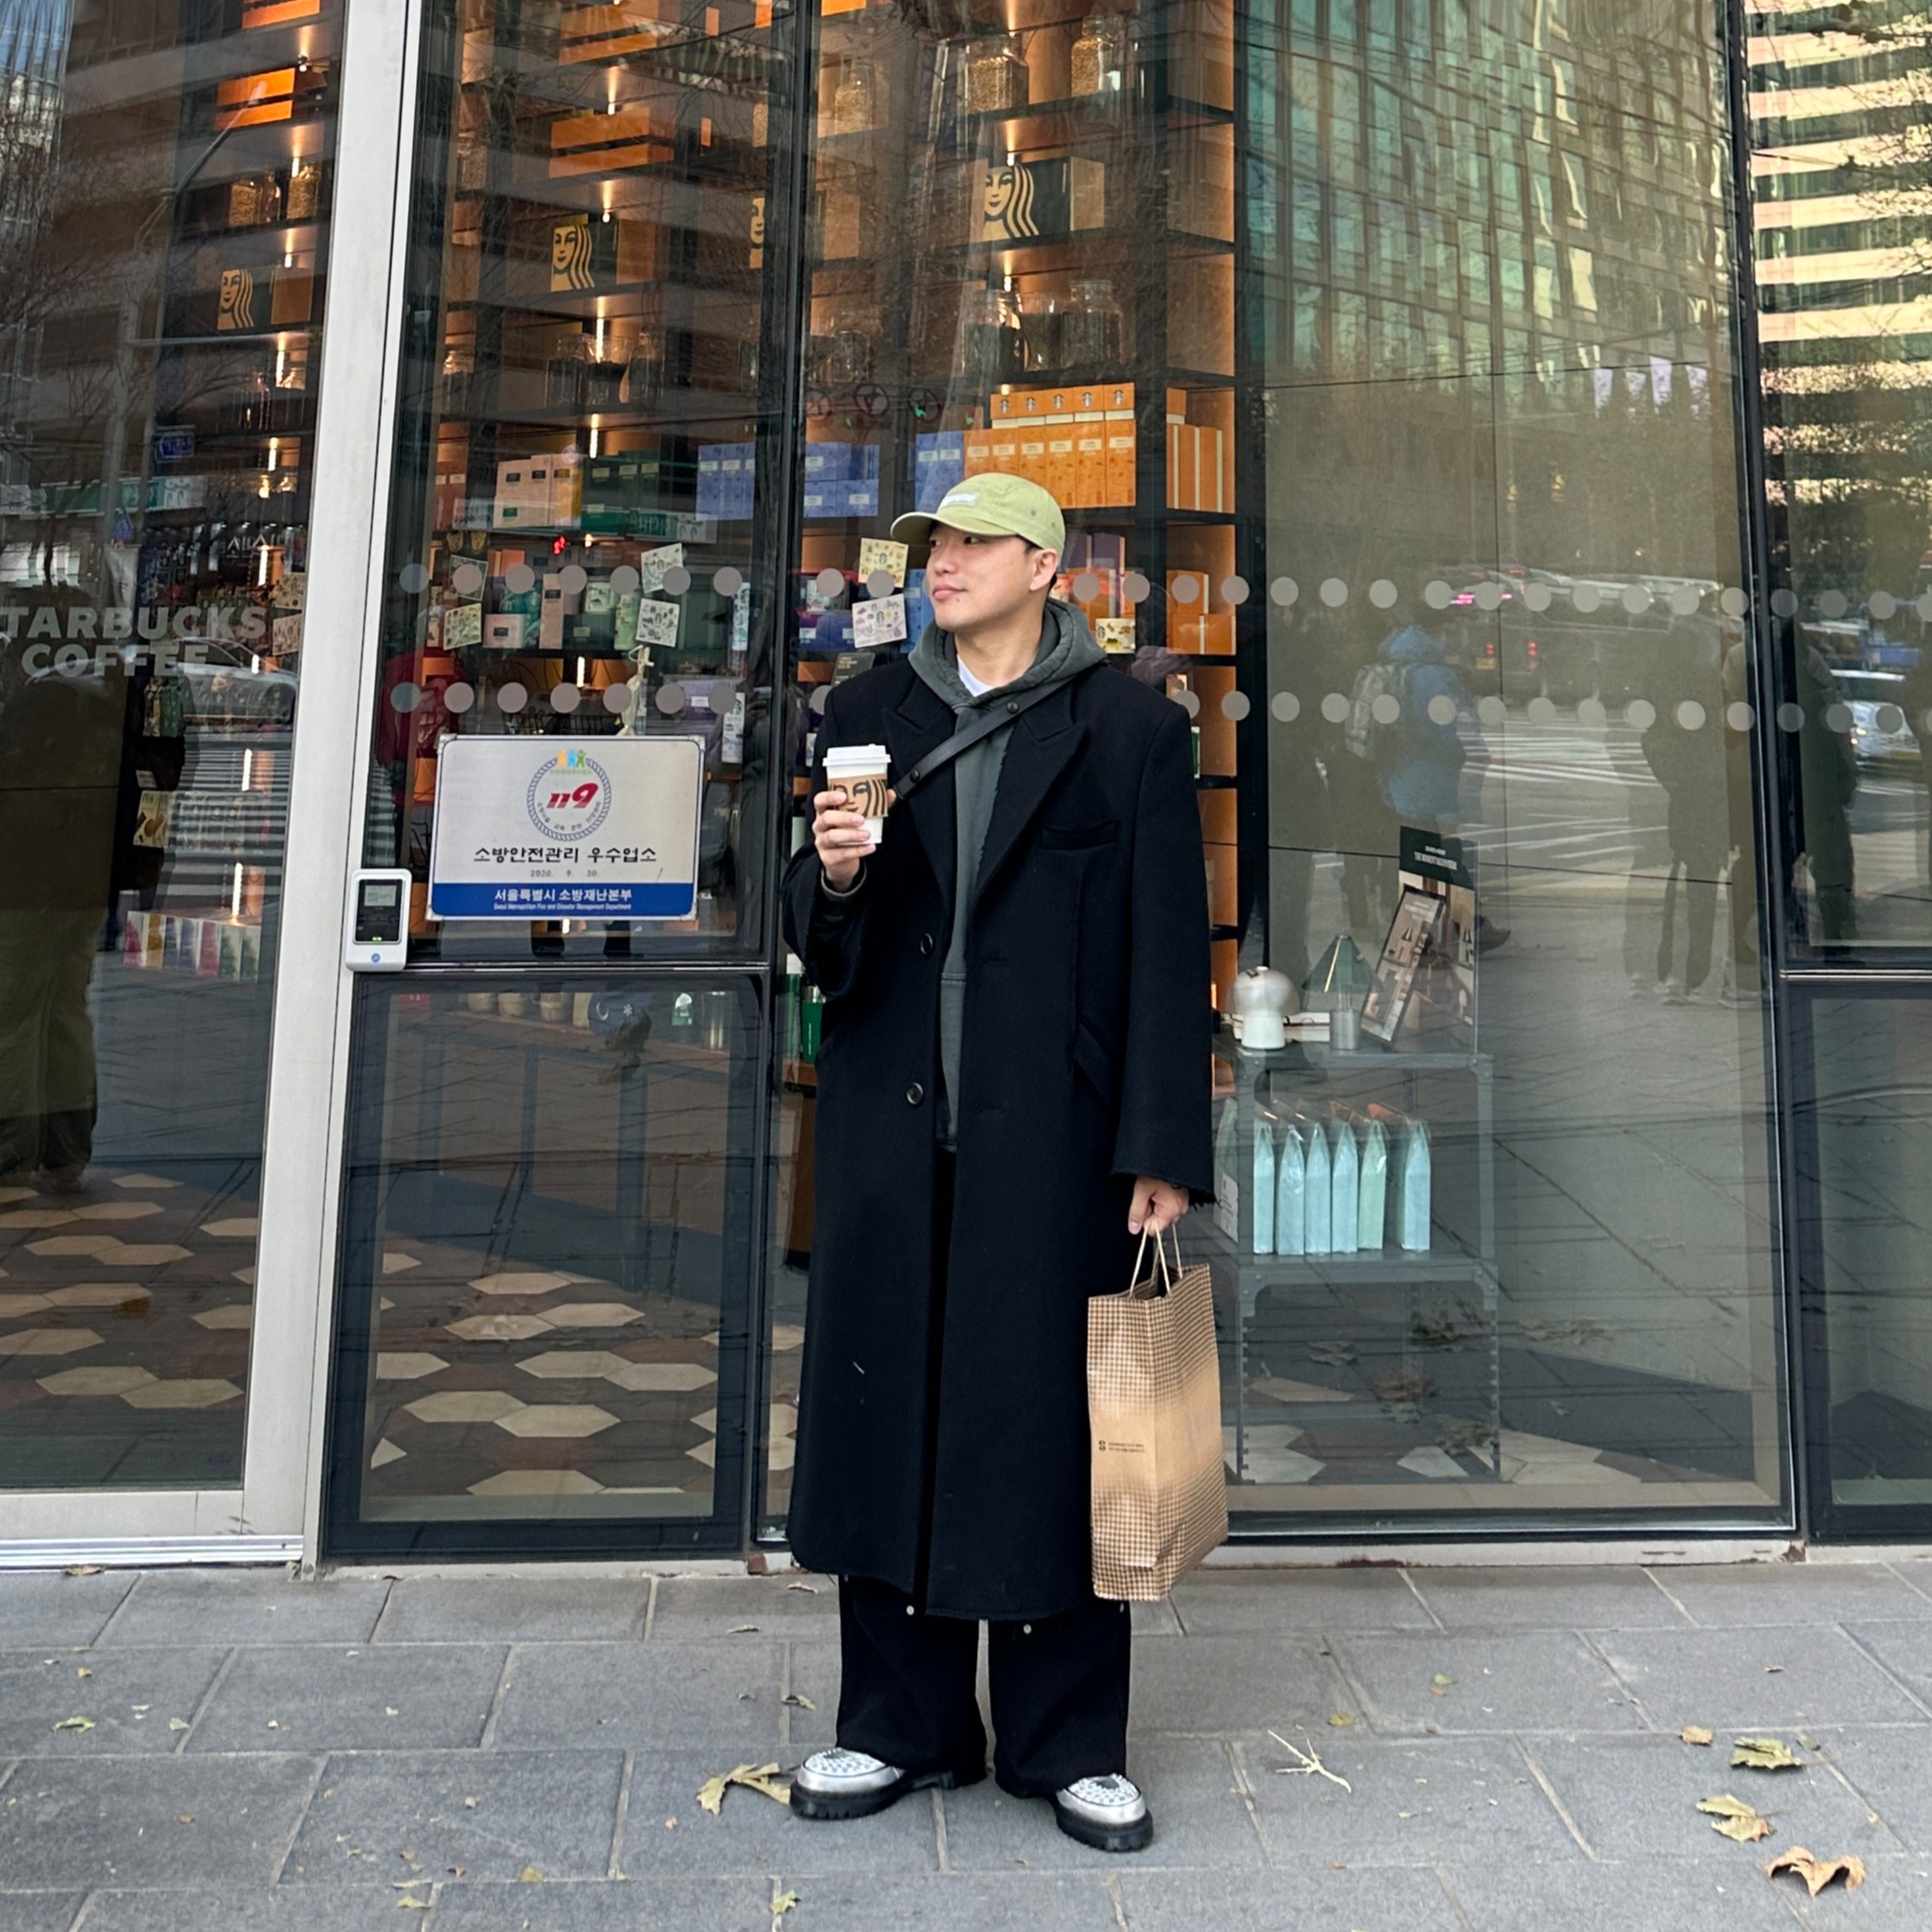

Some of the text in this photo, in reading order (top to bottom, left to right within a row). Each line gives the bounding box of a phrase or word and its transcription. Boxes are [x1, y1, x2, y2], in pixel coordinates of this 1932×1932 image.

[21, 643, 209, 678] COFFEE
[546, 782, 599, 809] 119
[474, 847, 657, 864] 소방안전관리 우수업소
[494, 889, 633, 901] 서울특별시 소방재난본부
